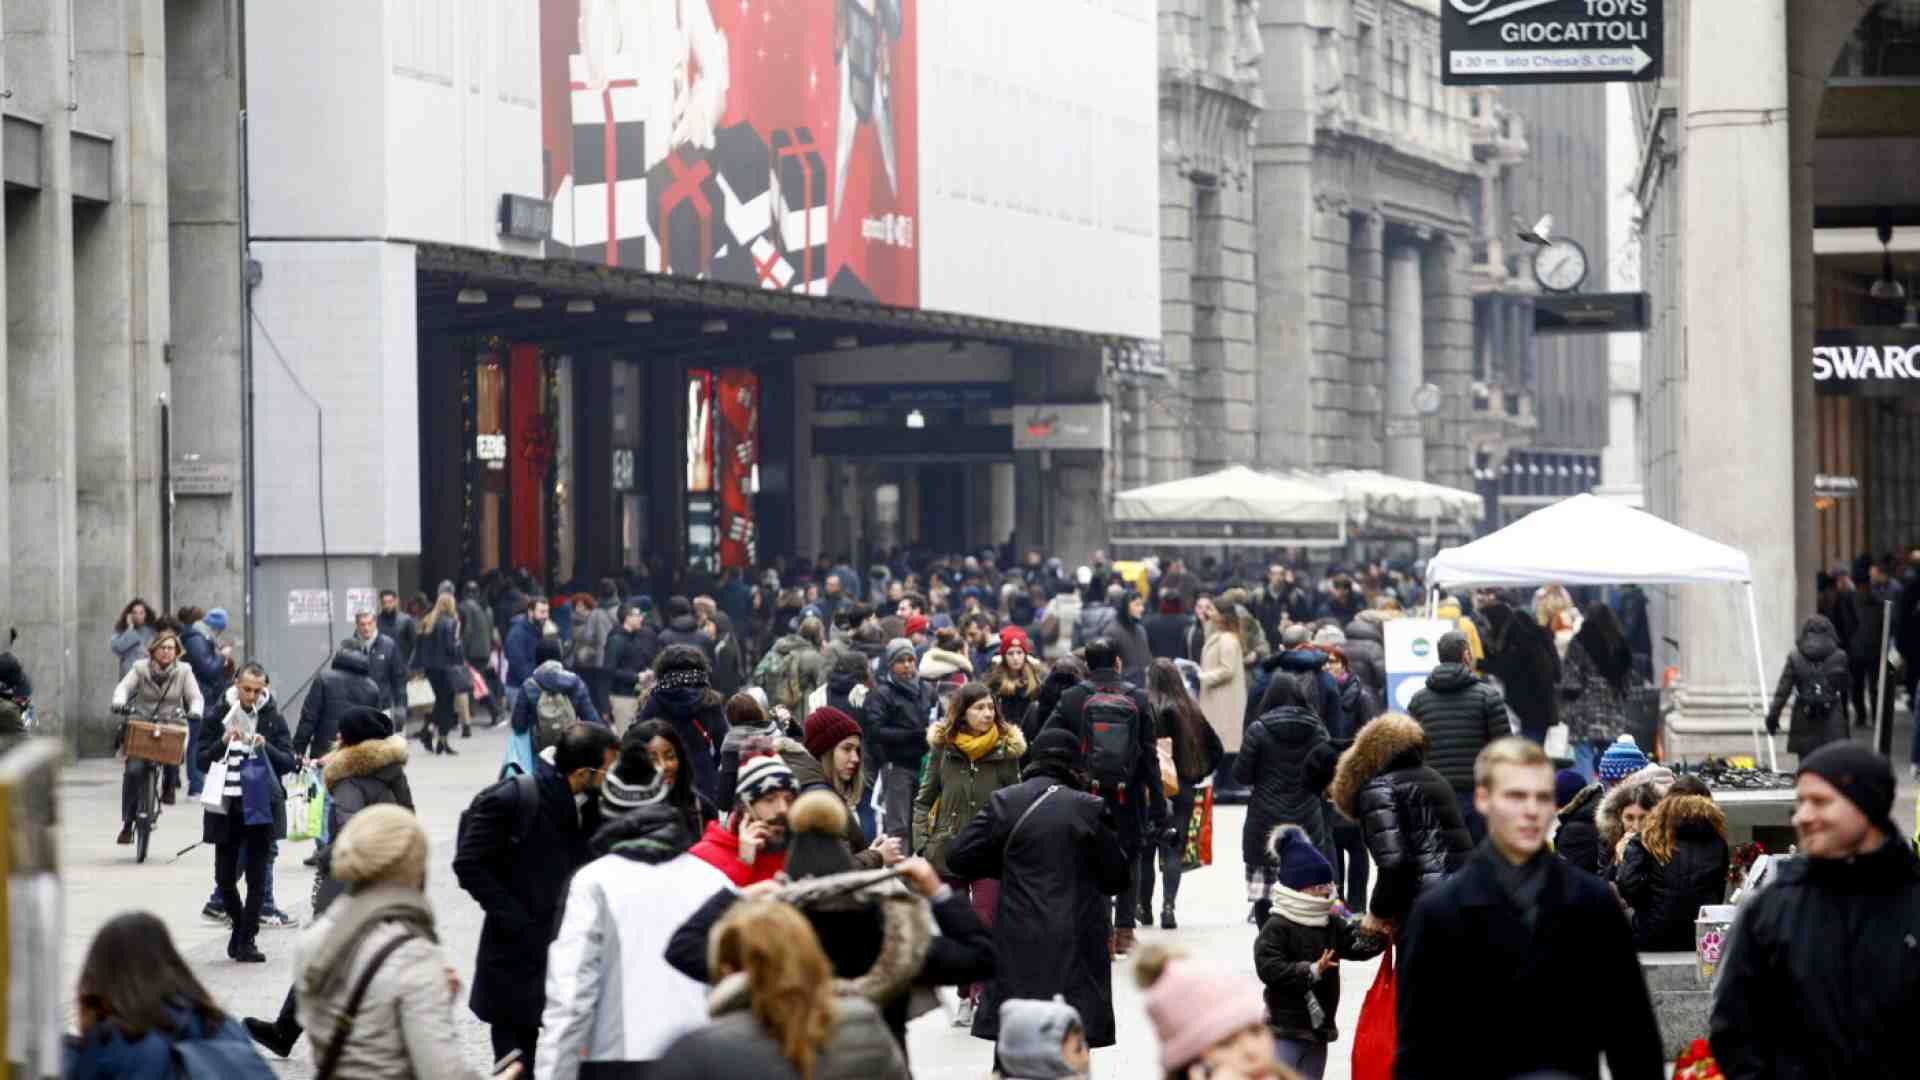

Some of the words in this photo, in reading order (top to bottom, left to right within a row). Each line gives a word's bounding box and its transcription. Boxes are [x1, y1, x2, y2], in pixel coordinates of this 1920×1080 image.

[1584, 0, 1647, 16] TOYS
[1501, 21, 1648, 42] GIOCATTOLI
[1466, 56, 1481, 67] 30
[1533, 54, 1579, 66] Chiesa
[1599, 53, 1634, 65] Carlo
